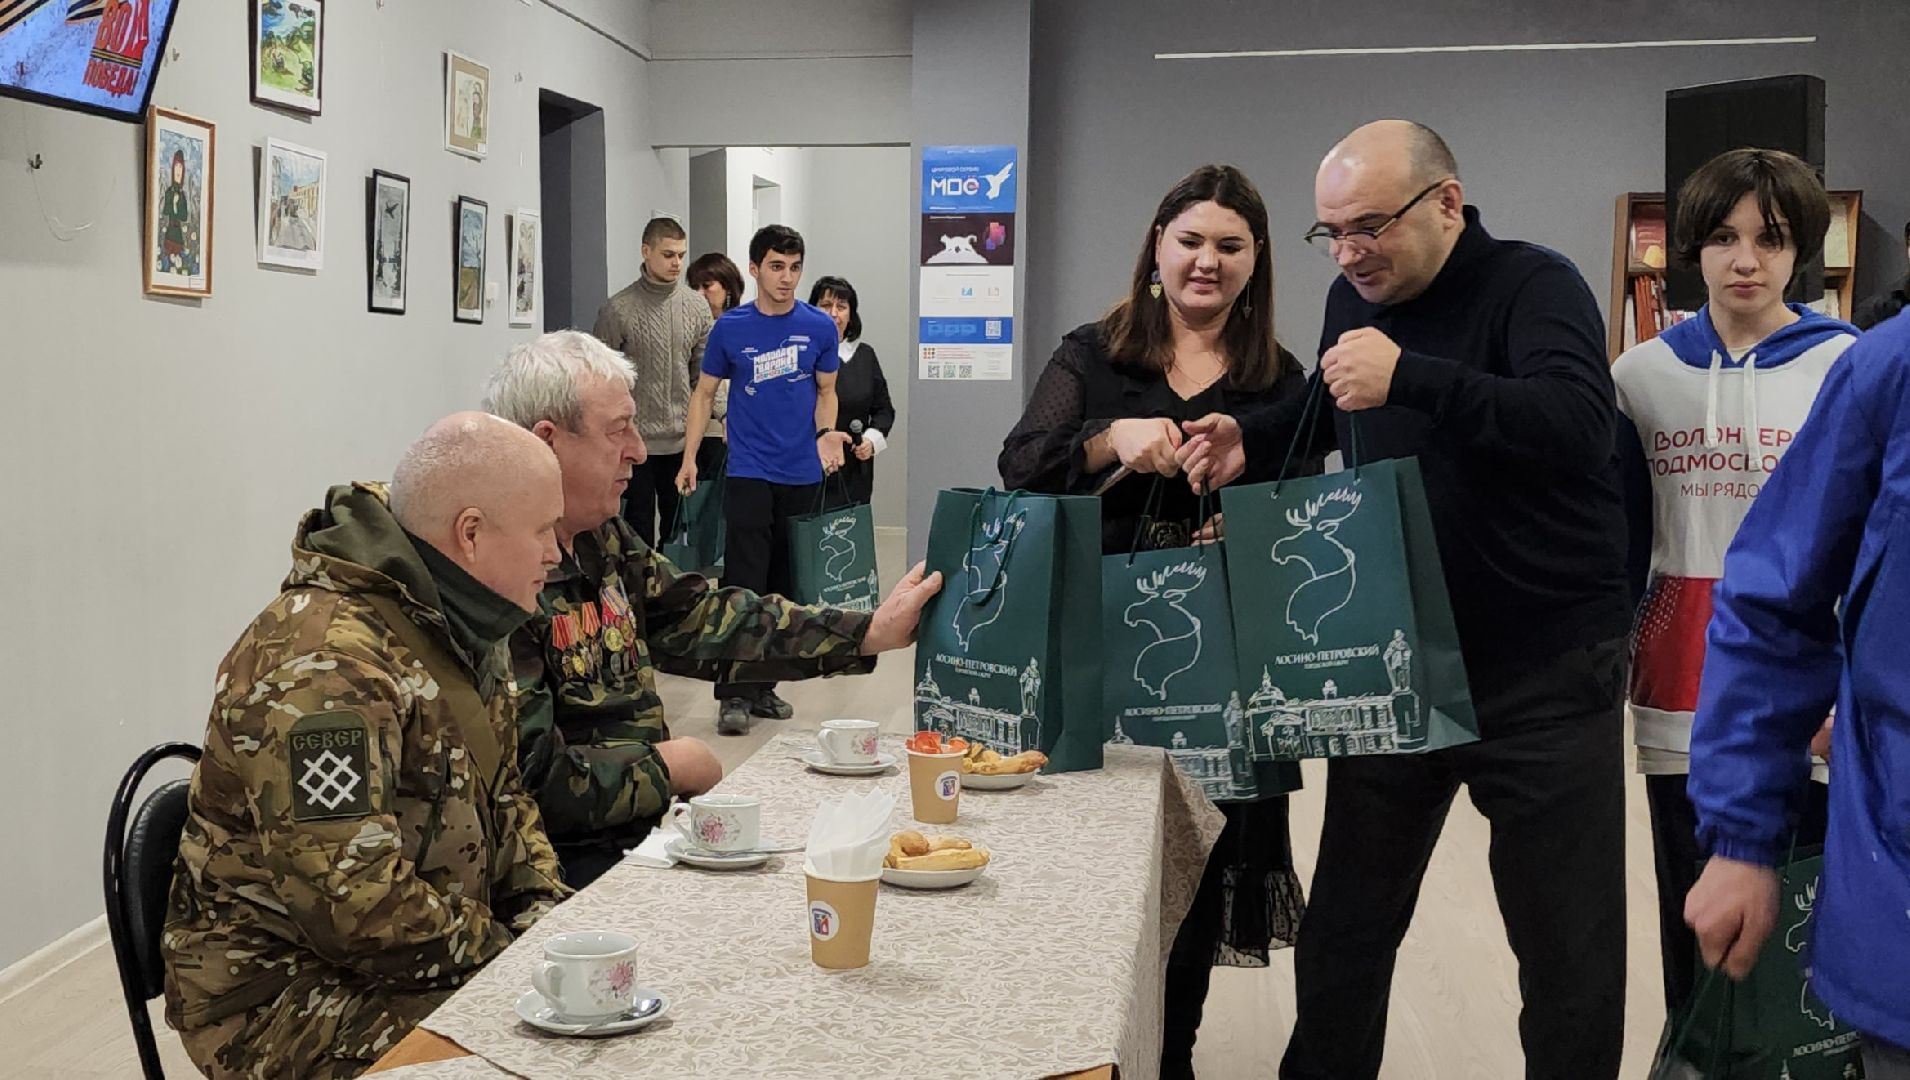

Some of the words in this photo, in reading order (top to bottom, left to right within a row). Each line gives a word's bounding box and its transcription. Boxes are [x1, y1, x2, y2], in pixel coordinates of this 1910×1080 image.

[1654, 427, 1793, 451] ВОЛНЕР
[1681, 483, 1709, 497] МЫ
[1275, 643, 1380, 665] ЛОСИНО-ПЕТРОВСКИЙ
